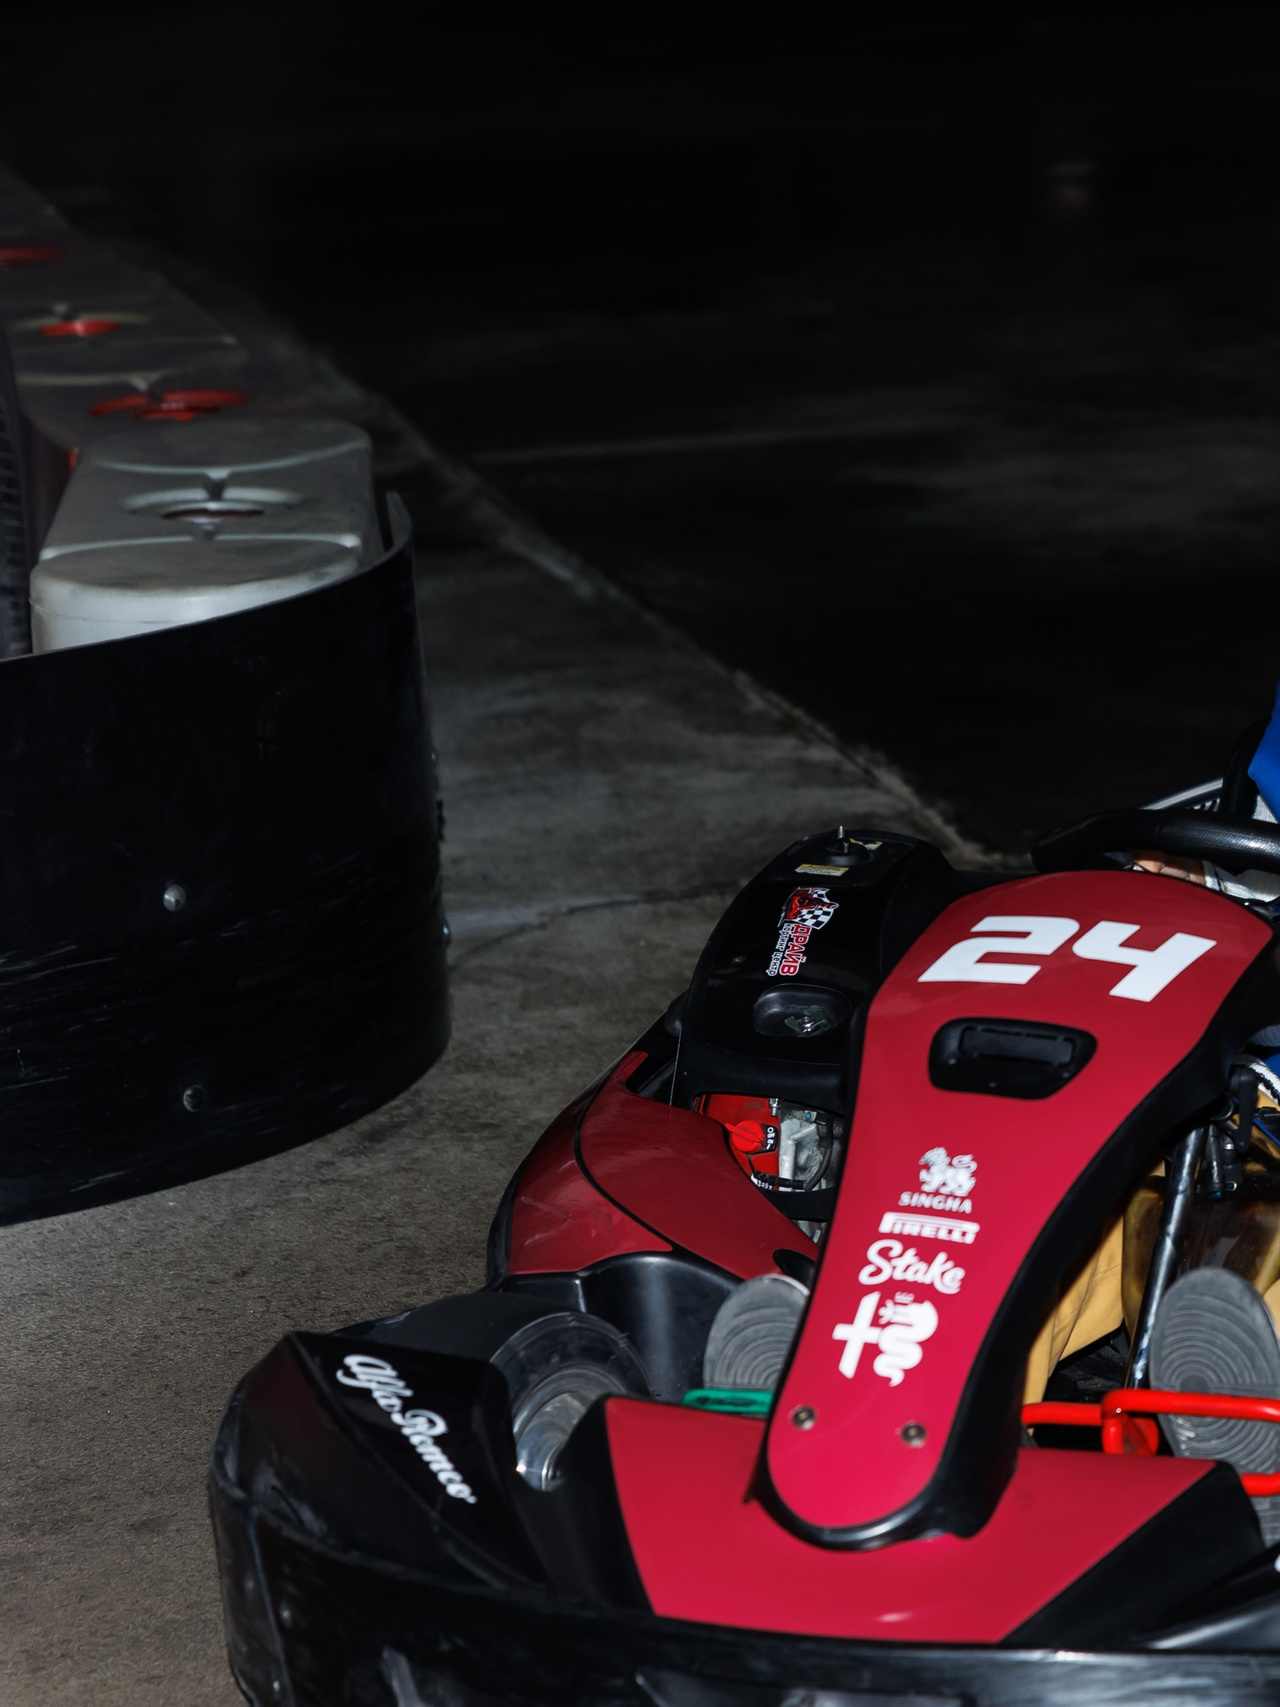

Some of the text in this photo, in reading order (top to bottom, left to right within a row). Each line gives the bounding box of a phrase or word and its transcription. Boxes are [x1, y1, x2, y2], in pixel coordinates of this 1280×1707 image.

[766, 951, 784, 977] центр
[780, 924, 812, 975] ДРАЙВ
[917, 915, 1217, 1002] 24
[878, 1212, 980, 1244] PIRELLI
[898, 1191, 973, 1214] SINGHA
[858, 1239, 965, 1294] Stake
[336, 1354, 477, 1504] Alfa Romeo
